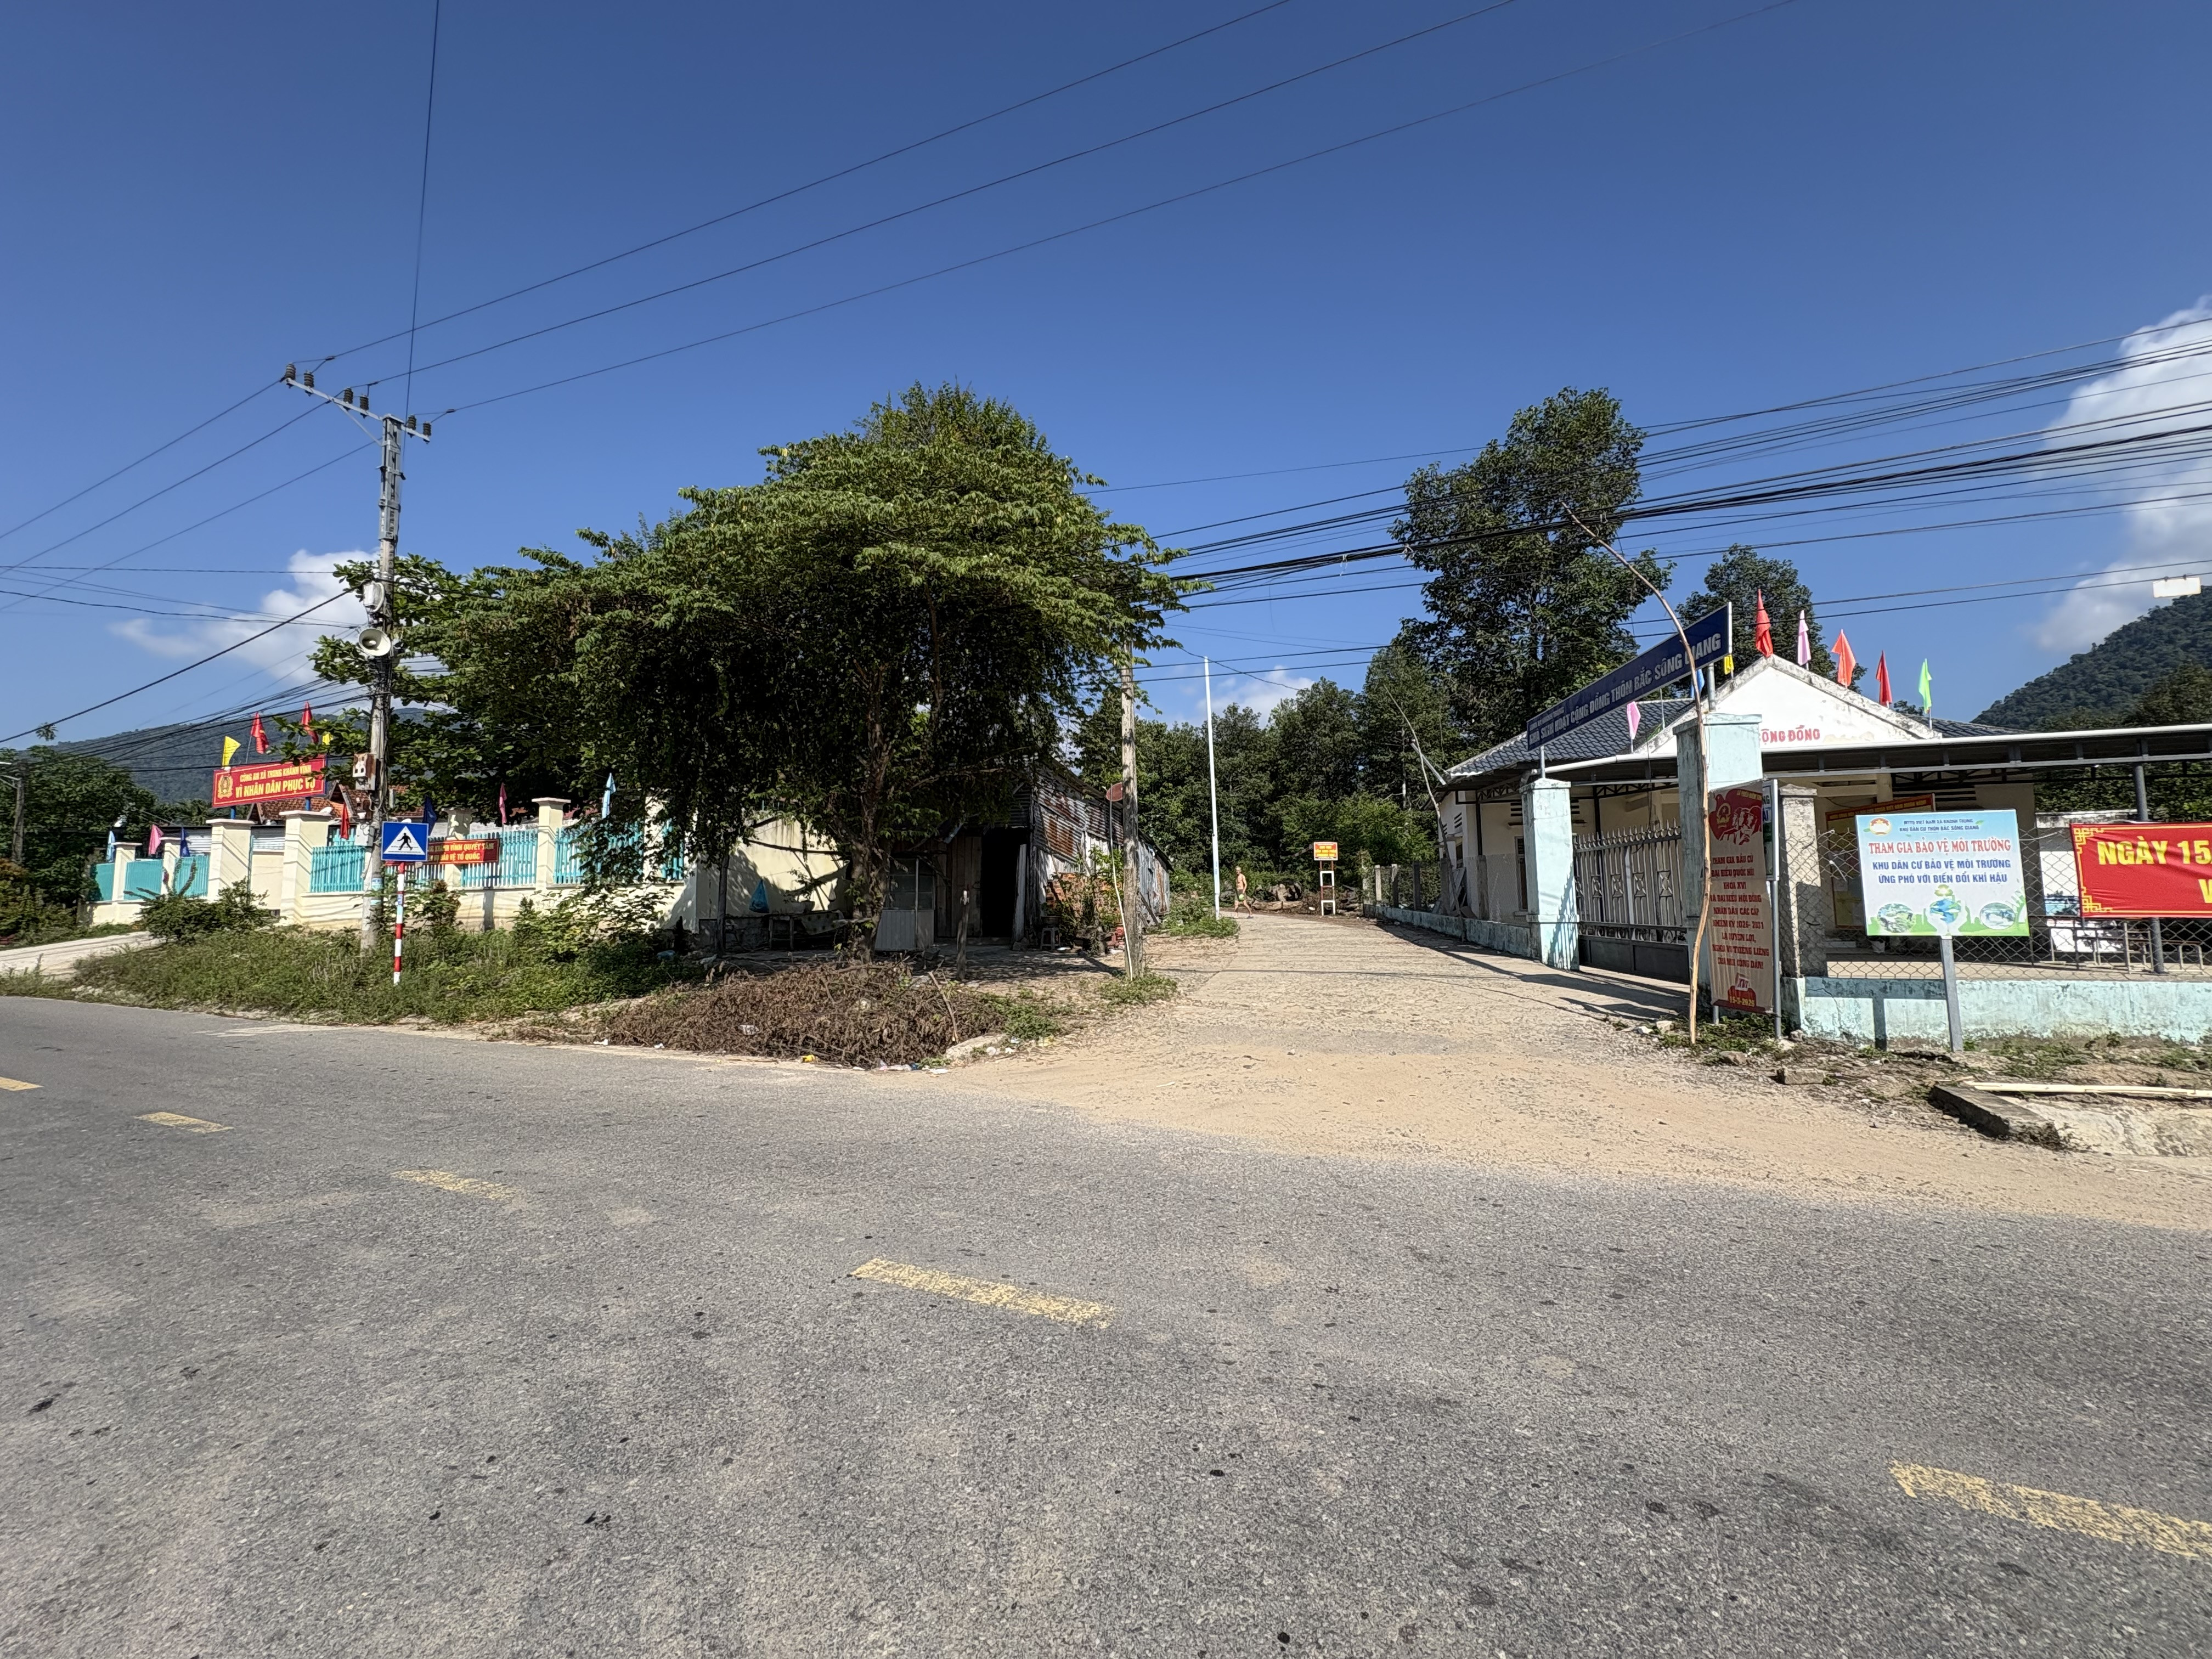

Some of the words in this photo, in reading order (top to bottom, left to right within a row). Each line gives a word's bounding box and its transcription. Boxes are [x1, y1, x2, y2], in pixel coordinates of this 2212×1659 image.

[1555, 714, 1571, 732] HOẠT
[1571, 704, 1589, 724] CỘNG
[1589, 692, 1610, 714] ĐỒNG
[1611, 680, 1633, 702] THÔN
[1634, 667, 1652, 691] BẮC
[1655, 653, 1683, 680] SÔNG
[1760, 729, 1786, 745] ỘNG
[240, 772, 252, 782] CÔNG
[283, 765, 299, 776] KHÁNH
[235, 784, 242, 798] VÌ
[244, 782, 264, 797] NHÂN
[265, 780, 281, 794] DÂN
[282, 778, 303, 793] PHỤC
[305, 777, 315, 791] VỤ
[1868, 842, 1894, 854] THAM
[1897, 842, 1913, 853] GIA
[1915, 837, 1934, 853] BẢO
[1936, 837, 1950, 856] VỆ
[1951, 837, 1970, 852] MÔI
[1971, 837, 2011, 852] TRƯỜNG
[2096, 836, 2168, 865] NGÀY
[2177, 840, 2212, 865] 15
[1872, 862, 1889, 870] KHU
[1892, 860, 1909, 870] DÂN
[1911, 860, 1923, 870] CƯ
[1925, 858, 1942, 869] BẢO
[1944, 859, 1955, 871] VỆ
[1957, 859, 1974, 868] MÔI
[1976, 858, 2011, 868] TRƯỜNG
[1878, 873, 1895, 883] ỨNG
[1898, 873, 1915, 883] PHÓ
[1917, 873, 1931, 883] VỚI
[1933, 872, 1953, 883] BIẾN
[1955, 871, 1970, 883] ĐỔI
[1972, 872, 1987, 883] KHÍ
[1989, 872, 2007, 884] HẬU
[1740, 906, 1750, 915] CÁC
